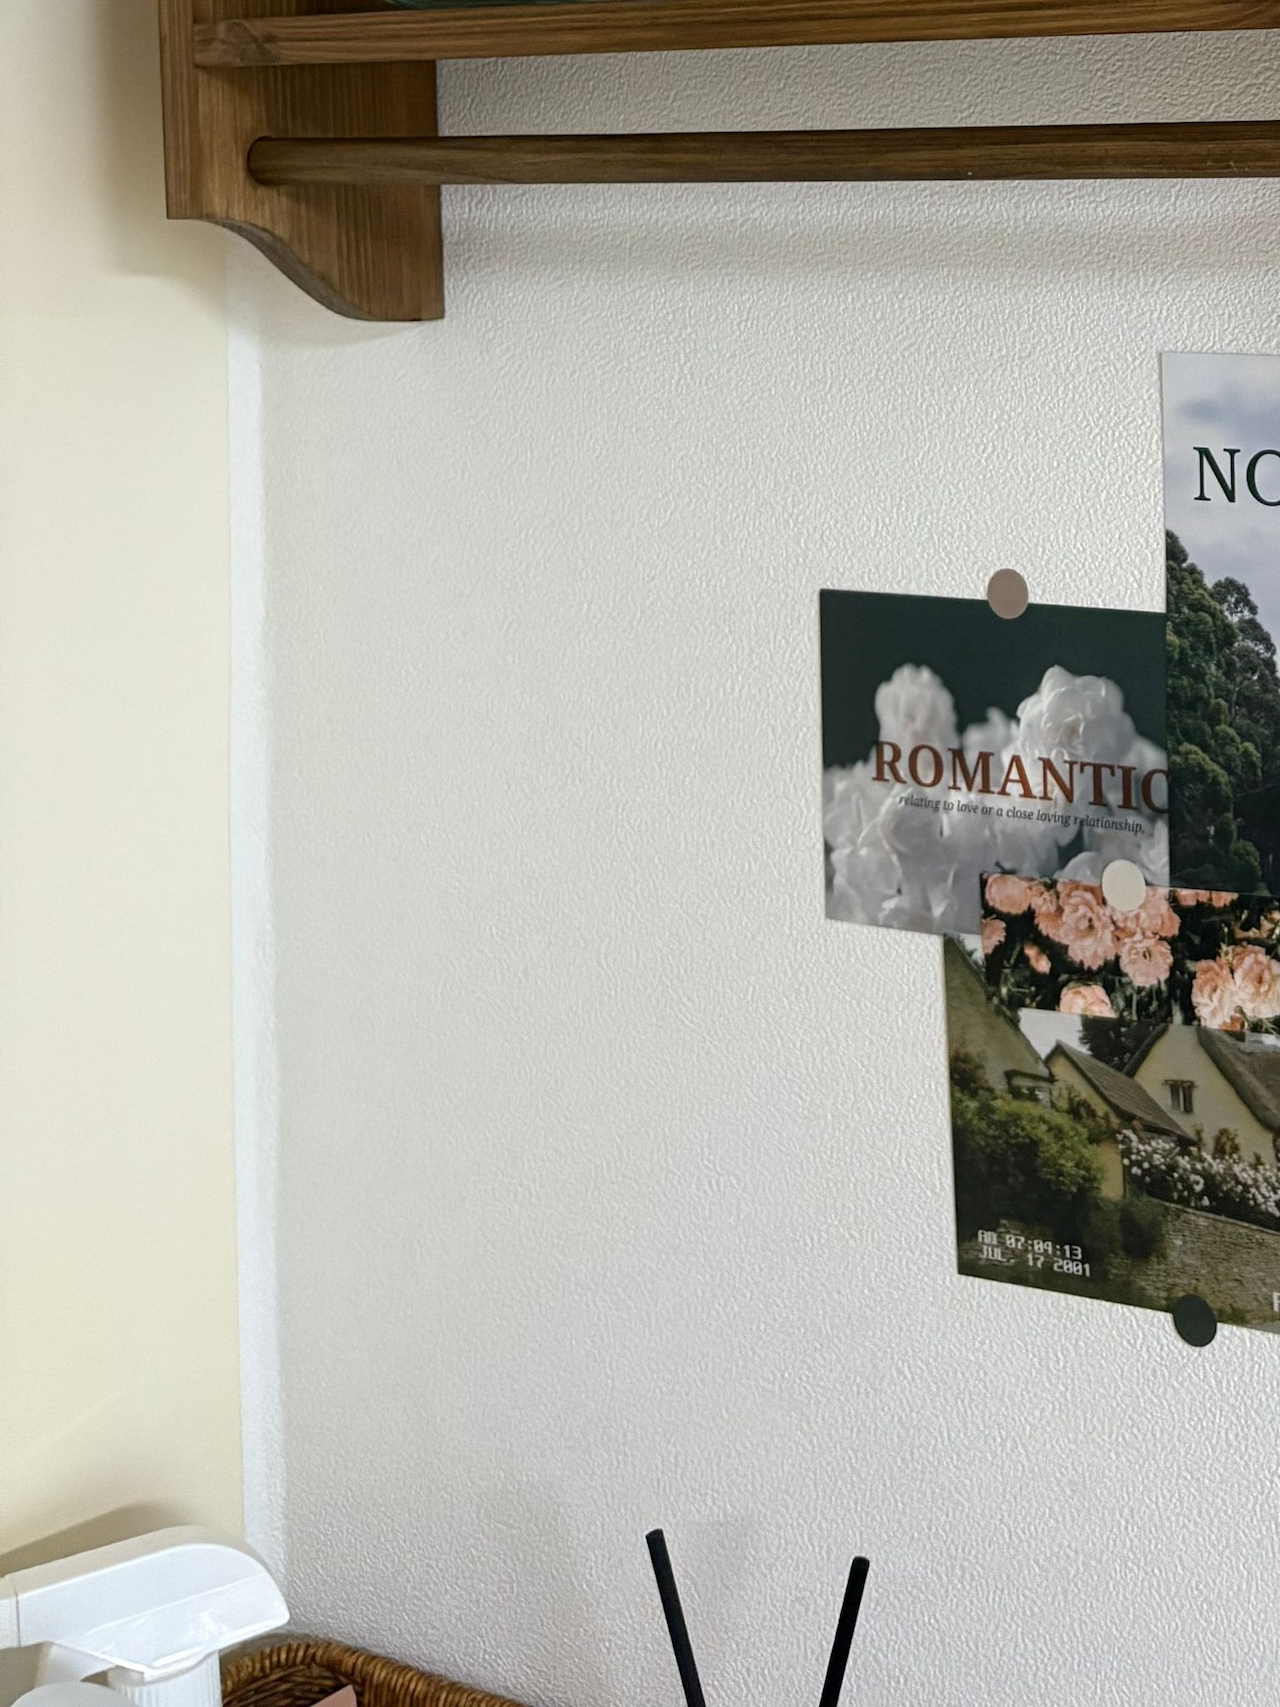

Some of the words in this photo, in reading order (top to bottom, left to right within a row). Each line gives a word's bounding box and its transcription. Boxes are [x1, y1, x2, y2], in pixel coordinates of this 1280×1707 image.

[872, 740, 1170, 814] ROMANTIC
[899, 795, 940, 812] relating
[943, 801, 955, 811] to
[956, 800, 979, 814] love
[981, 806, 994, 815] or
[996, 808, 1003, 817] a
[1006, 807, 1034, 820] close
[1036, 810, 1071, 828] loving
[977, 1229, 998, 1245] AM
[1027, 1253, 1045, 1269] 17
[1053, 1256, 1091, 1277] 2001
